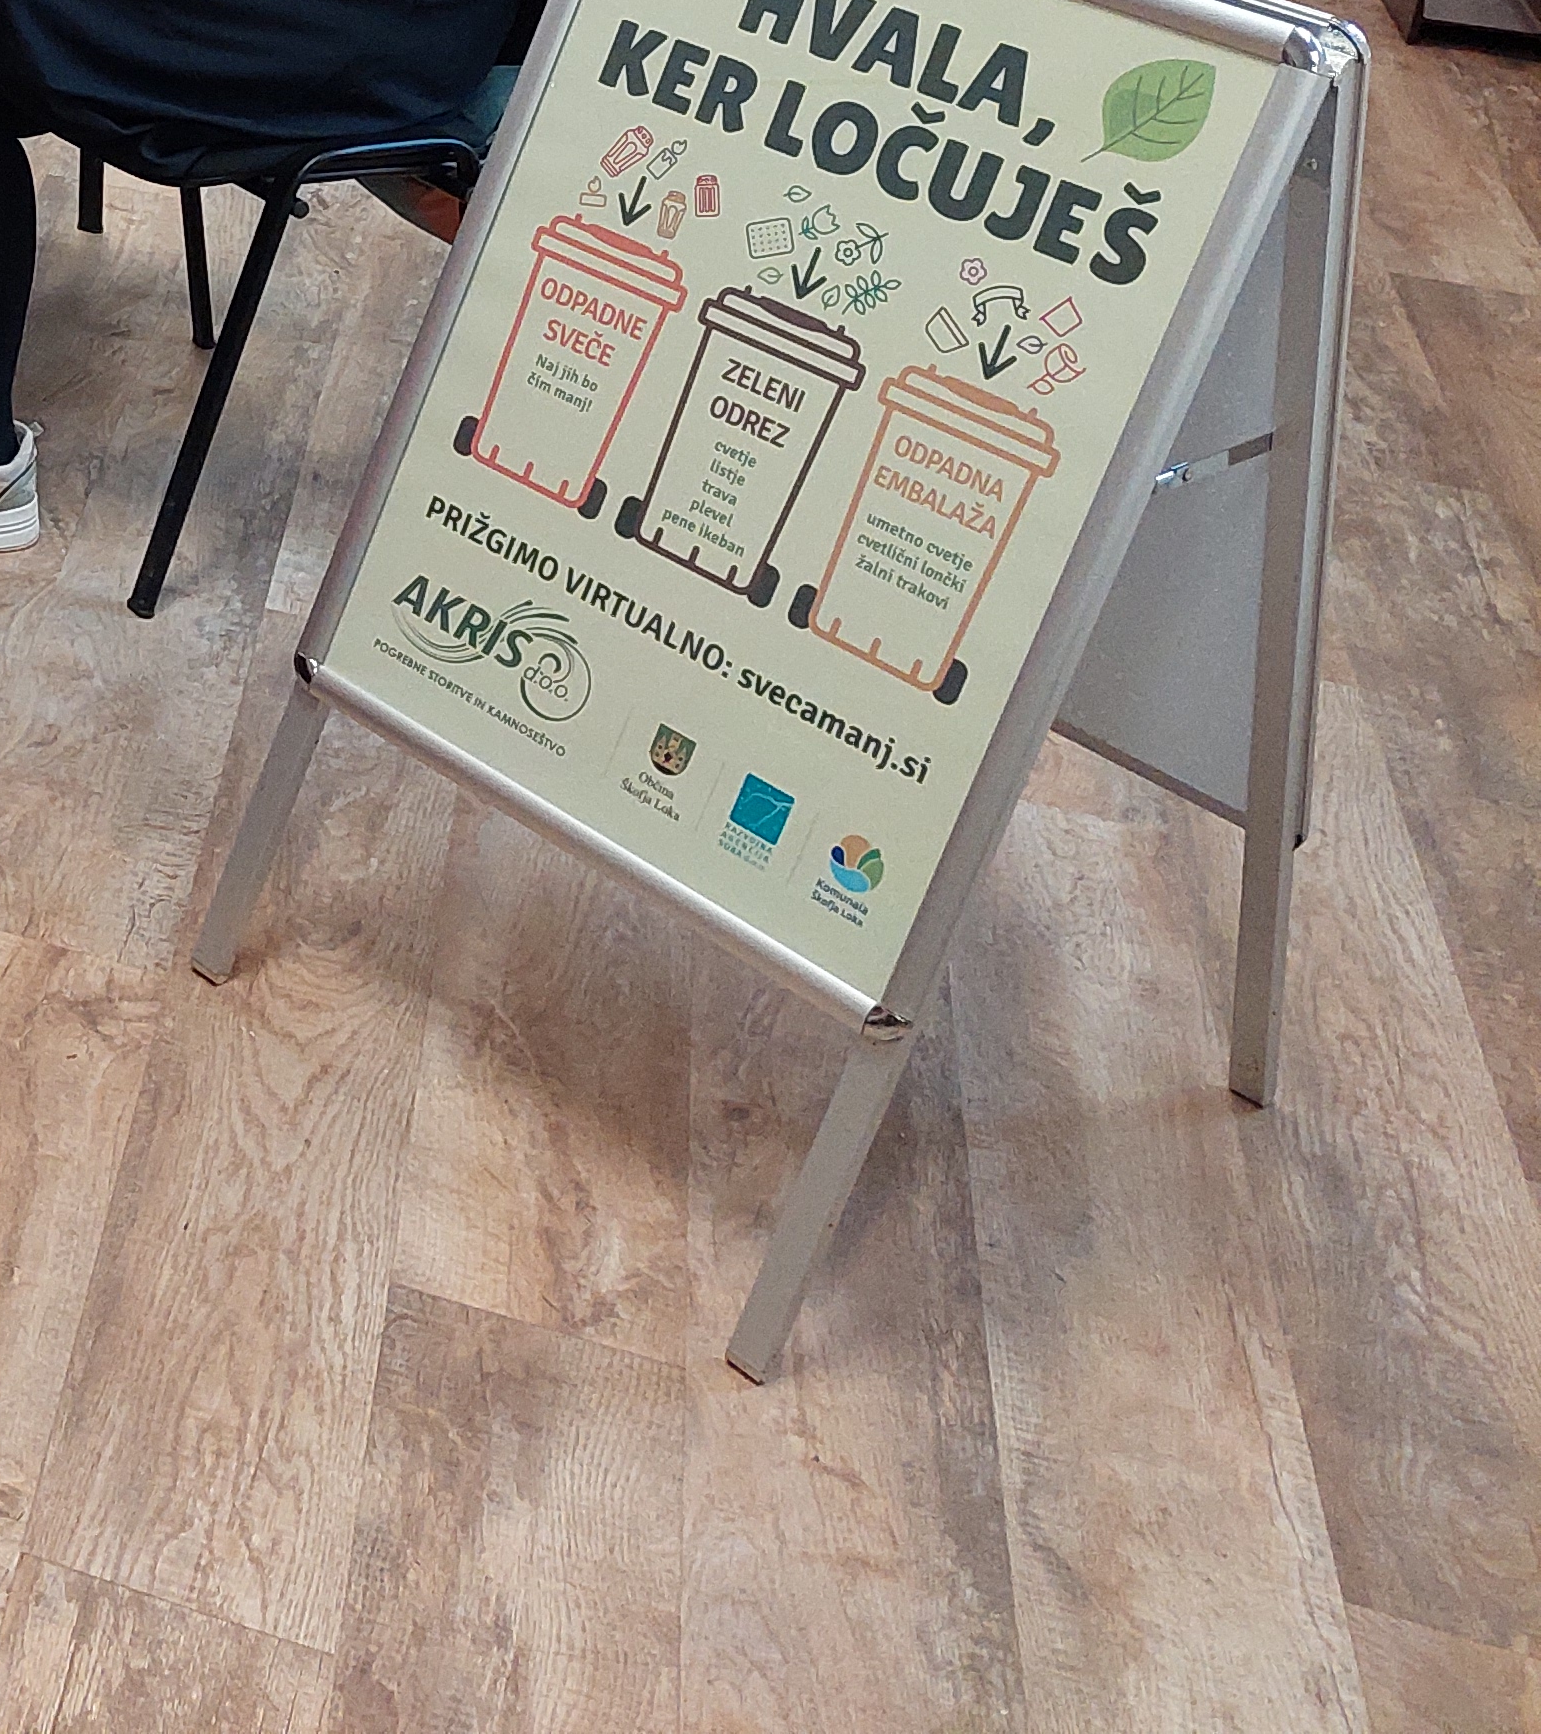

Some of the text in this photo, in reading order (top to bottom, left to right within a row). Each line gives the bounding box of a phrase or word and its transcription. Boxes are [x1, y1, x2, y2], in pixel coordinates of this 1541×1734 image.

[597, 18, 1163, 286] KER LOČUJEŠ
[539, 277, 649, 341] ODPADNE
[542, 319, 616, 367] SVEČE
[526, 371, 593, 413] čim manj!
[535, 353, 599, 392] Naj jih bo
[720, 357, 807, 414] ZELENI
[709, 395, 791, 449] ODREZ
[709, 458, 746, 486] listje
[714, 440, 757, 468] cvetje
[893, 434, 1005, 503] ODPADNA
[688, 499, 734, 528] plevel
[701, 478, 738, 506] trava
[872, 465, 997, 540] EMBALAŽA
[661, 508, 746, 558] pene ikeban
[866, 512, 974, 572] umetno cvetje
[854, 554, 951, 610] žalni trakovi
[856, 532, 967, 593] cvetlični lončki
[391, 573, 535, 669] AKRIS
[424, 495, 933, 786] PRIŽGIMO VIRTUALNO: svecamanj.si
[373, 637, 567, 757] POGREBNE STORITVE IN KAMNOSEŠTVO
[523, 665, 570, 702] d.o.o.
[619, 777, 681, 822] Škofja Loka
[638, 771, 675, 801] Občina
[810, 888, 864, 928] Škofja Loka
[815, 877, 869, 917] Komunala
